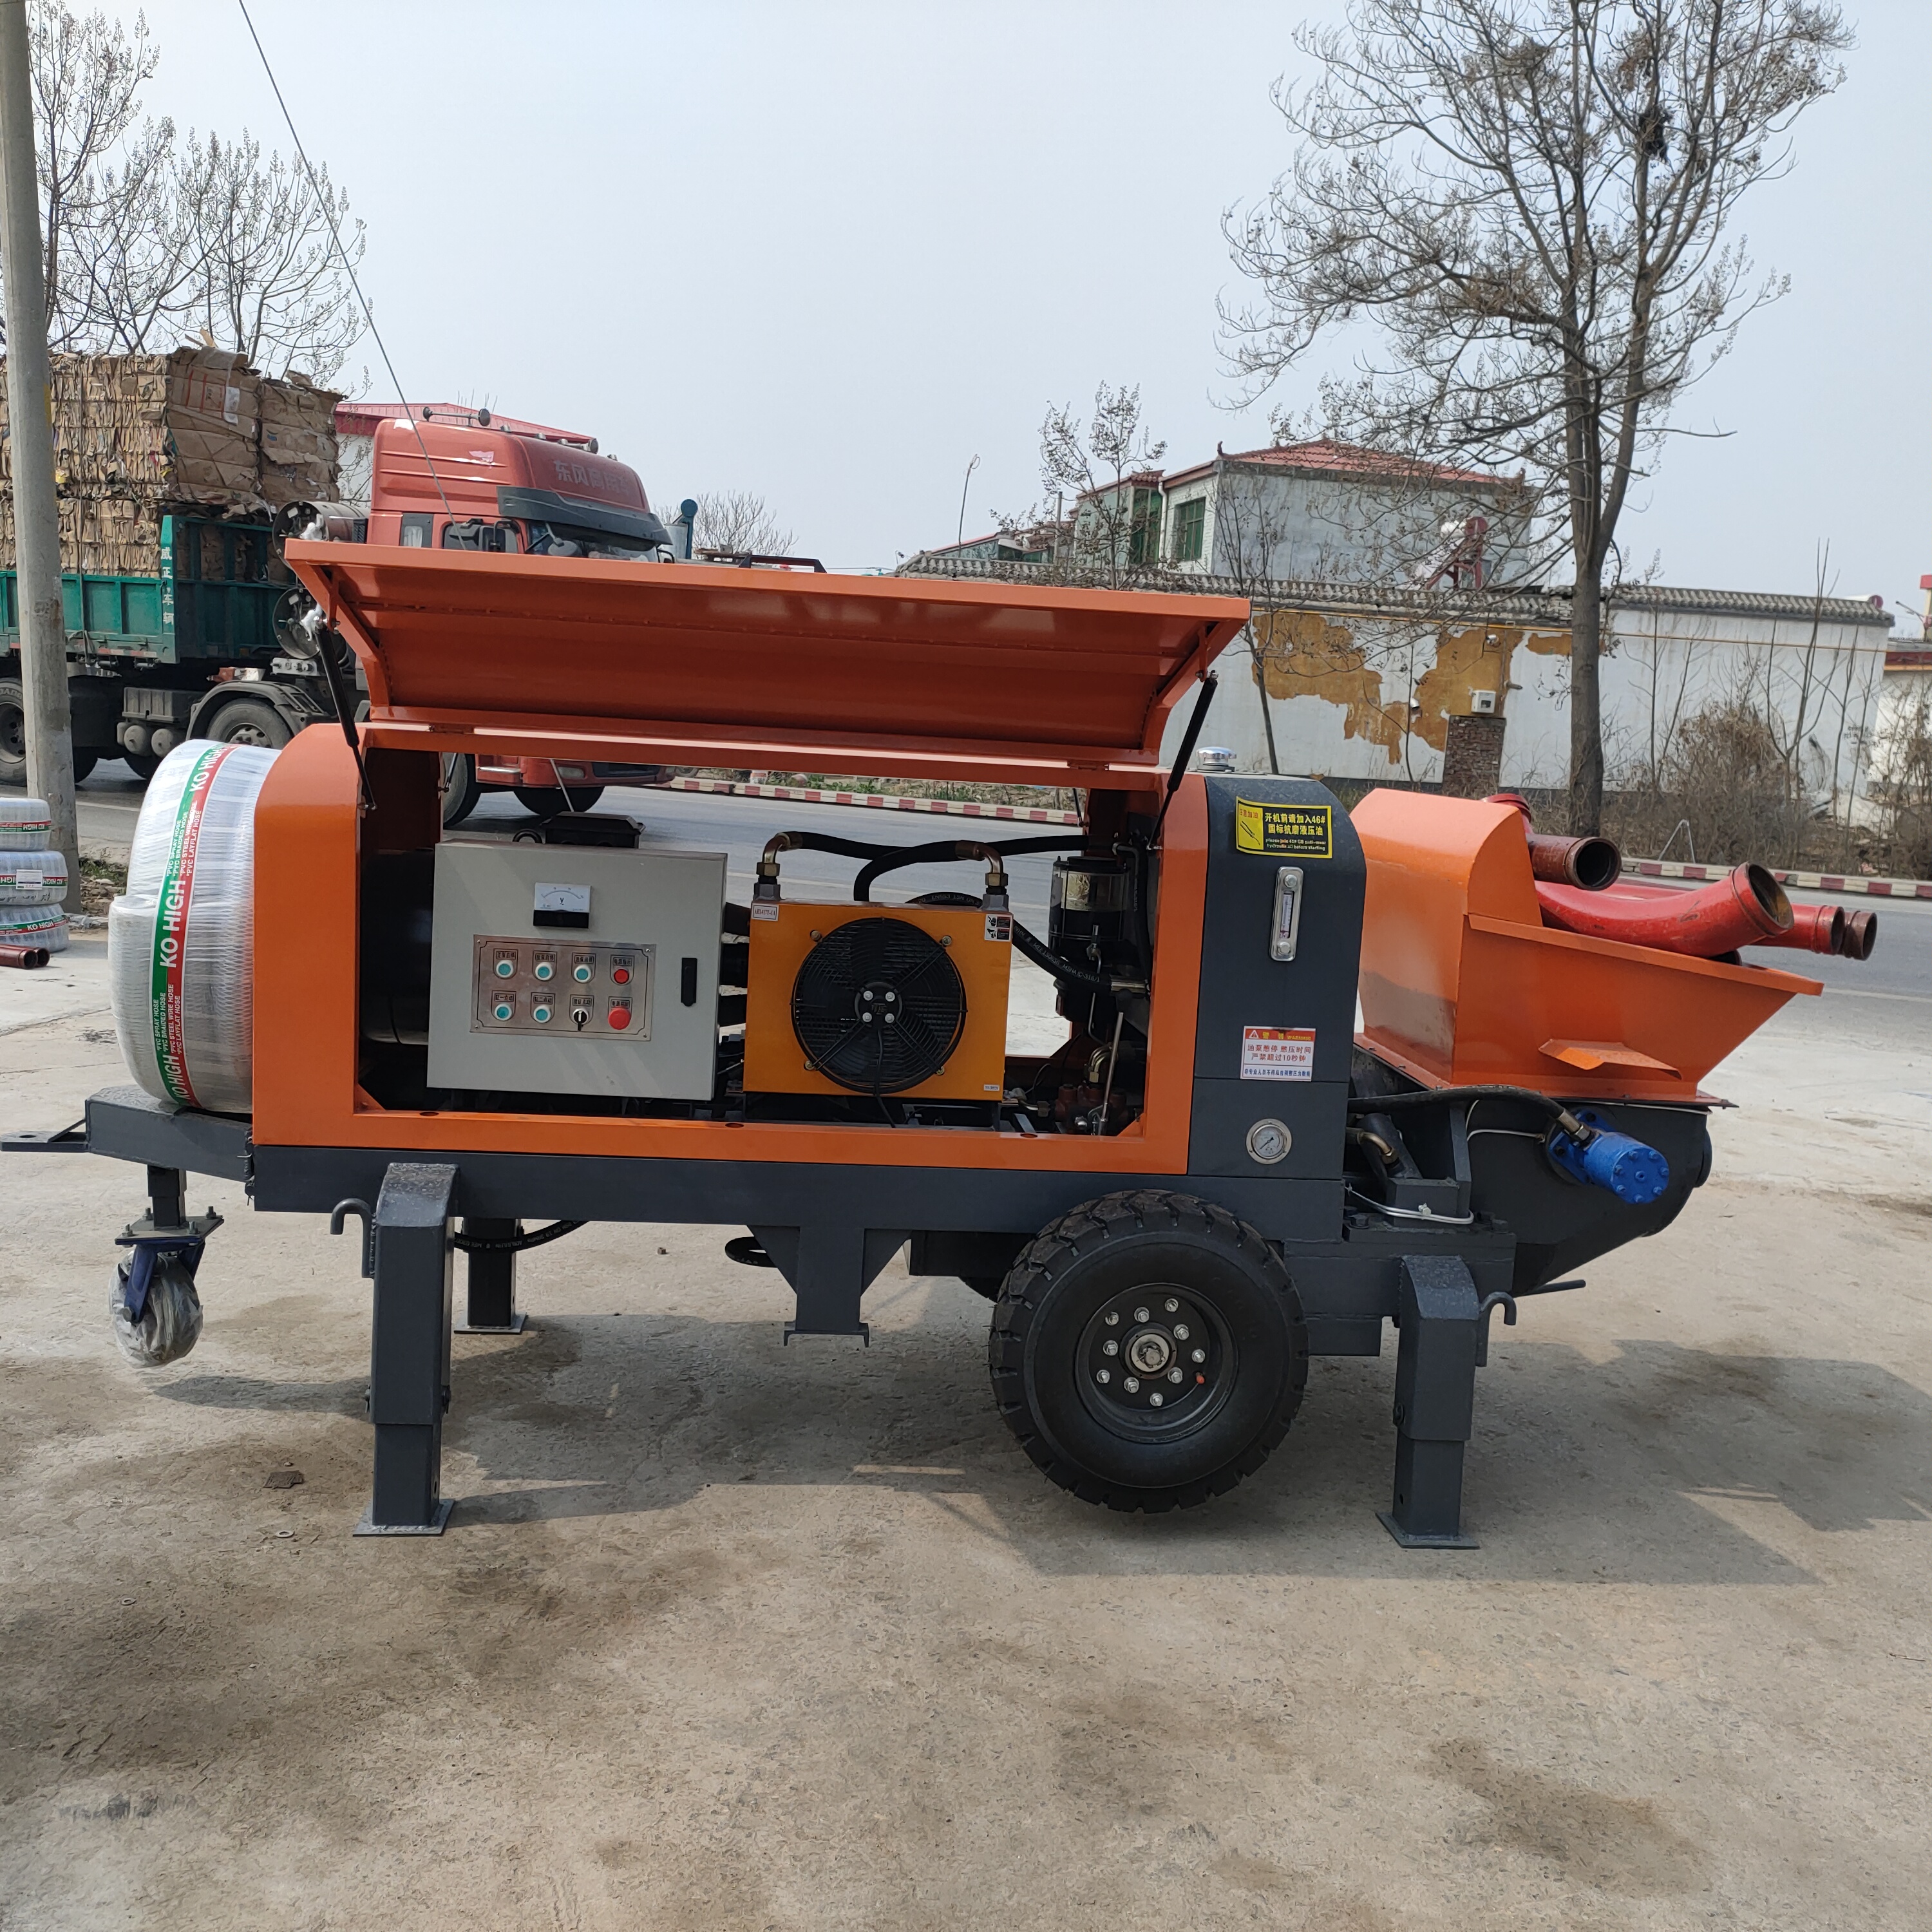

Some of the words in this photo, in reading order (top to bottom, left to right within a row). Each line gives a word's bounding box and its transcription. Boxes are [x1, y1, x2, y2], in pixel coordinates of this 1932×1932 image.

[189, 772, 210, 792] KO
[200, 747, 228, 770] HIGH
[165, 880, 186, 933] HIGH
[159, 936, 178, 969] KO
[162, 1054, 185, 1086] HIGH
